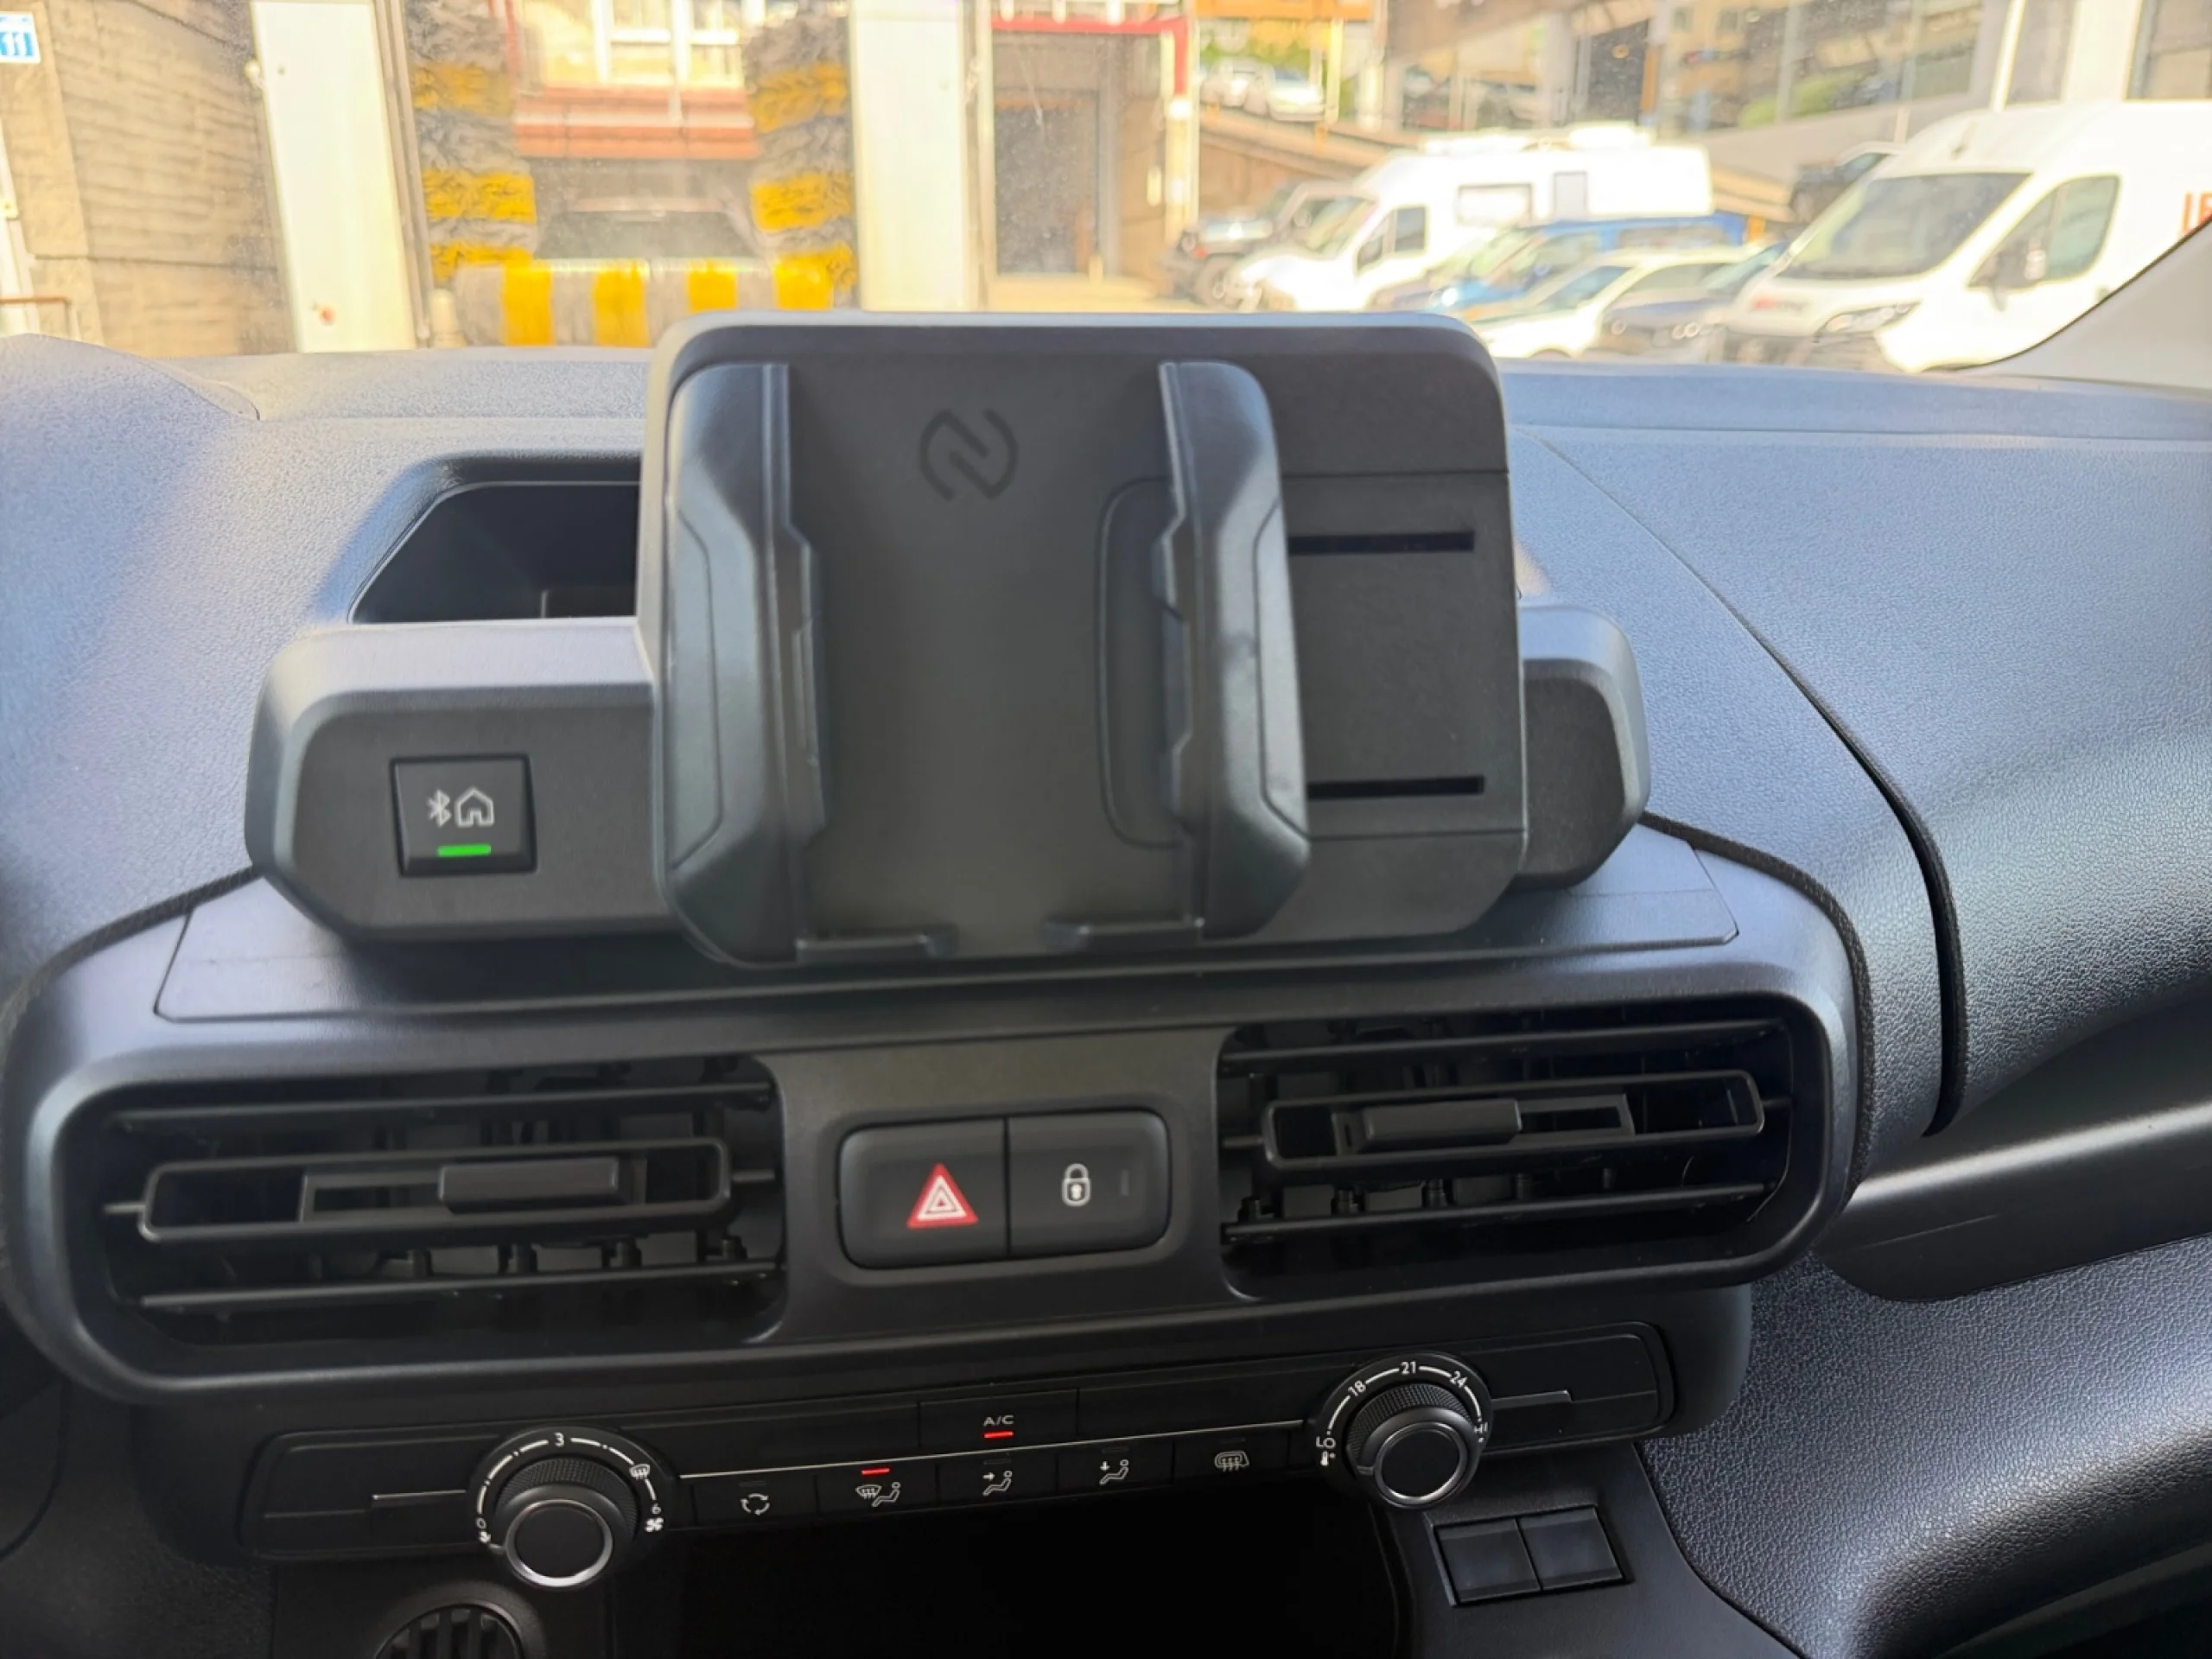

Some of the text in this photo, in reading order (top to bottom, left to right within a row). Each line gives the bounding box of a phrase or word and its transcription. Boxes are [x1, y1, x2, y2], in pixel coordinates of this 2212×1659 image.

[1401, 1362, 1417, 1375] 21
[1450, 1371, 1468, 1389] 24
[1348, 1380, 1367, 1397] 18
[983, 1414, 1014, 1427] A/C
[554, 1432, 566, 1448] 3
[652, 1503, 662, 1516] 6
